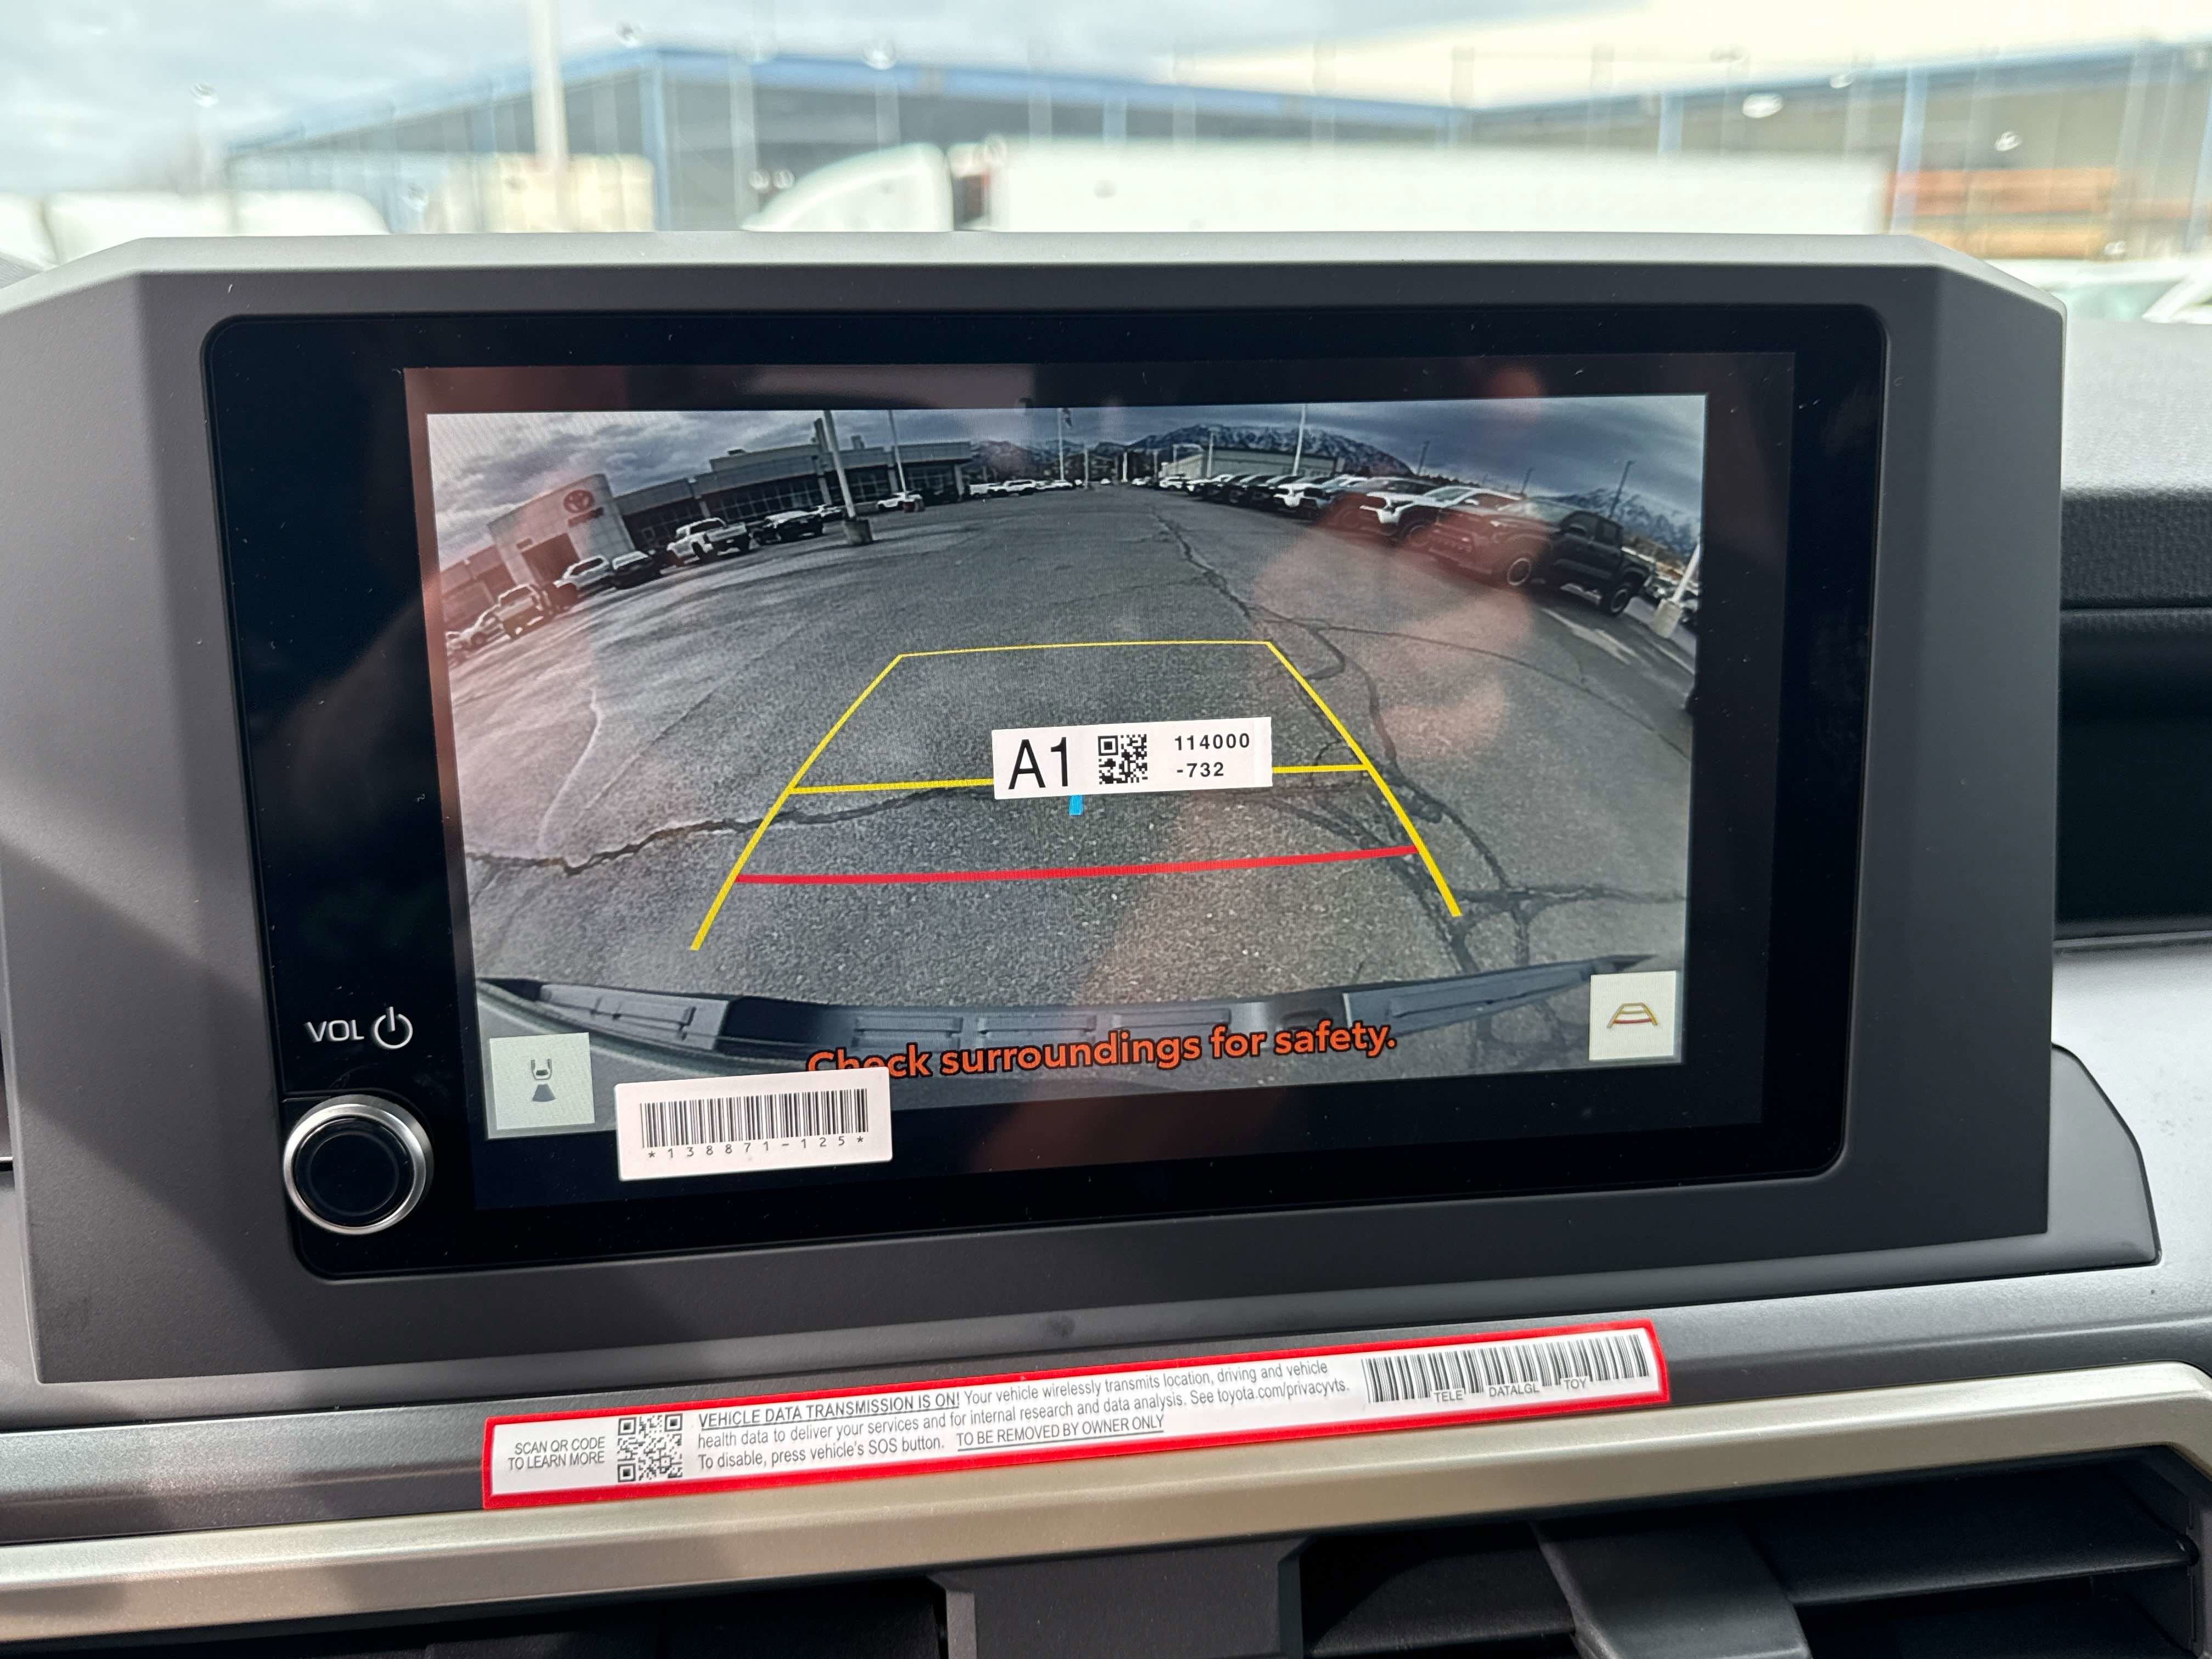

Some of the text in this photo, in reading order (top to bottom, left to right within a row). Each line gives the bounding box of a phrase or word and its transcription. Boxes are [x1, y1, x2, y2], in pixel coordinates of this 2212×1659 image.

[1175, 733, 1250, 750] 114000
[1008, 737, 1069, 789] A1
[1177, 761, 1224, 777] -732
[304, 1019, 364, 1042] VOL
[939, 1031, 1202, 1076] surroundings
[1210, 1024, 1267, 1059] for
[1274, 1020, 1396, 1058] safety.
[698, 1359, 1328, 1428] VEHICLE DATA TRANSMISSION IS ON! Your vehicle wirelessly transmits location, driving and vehicle
[1434, 1377, 1587, 1403] TELE DATALGL TOY
[698, 1378, 1350, 1448] health data to deliver your services and for internal research and data analysis. See toyota.com/privacyvts.
[515, 1436, 605, 1455] SCAN QR CODE
[698, 1414, 1164, 1469] To disable, press vehicle's SOS button. TO BE REMOVED BY OWNER ONLY
[509, 1451, 605, 1470] TO LEARN MORE
